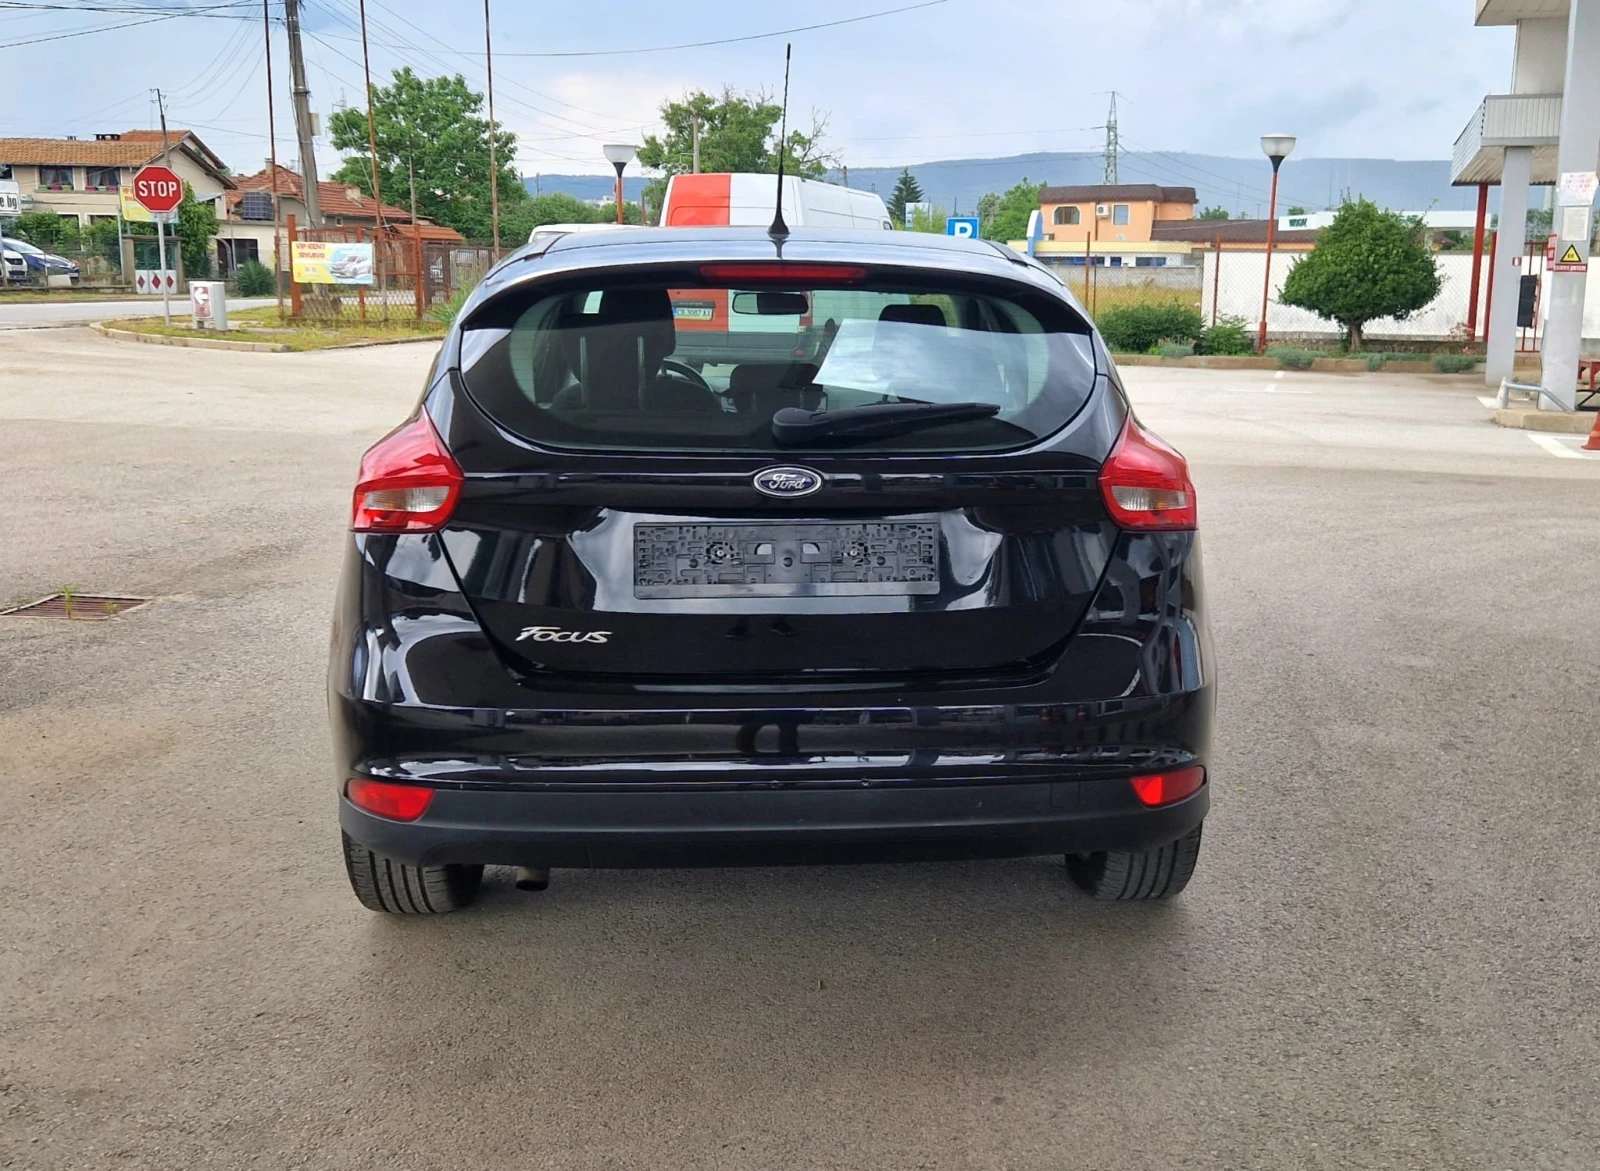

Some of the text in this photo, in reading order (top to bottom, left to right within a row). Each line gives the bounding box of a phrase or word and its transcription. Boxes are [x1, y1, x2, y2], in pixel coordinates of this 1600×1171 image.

[138, 180, 177, 197] STOP
[954, 222, 973, 239] P
[768, 473, 806, 489] Ford
